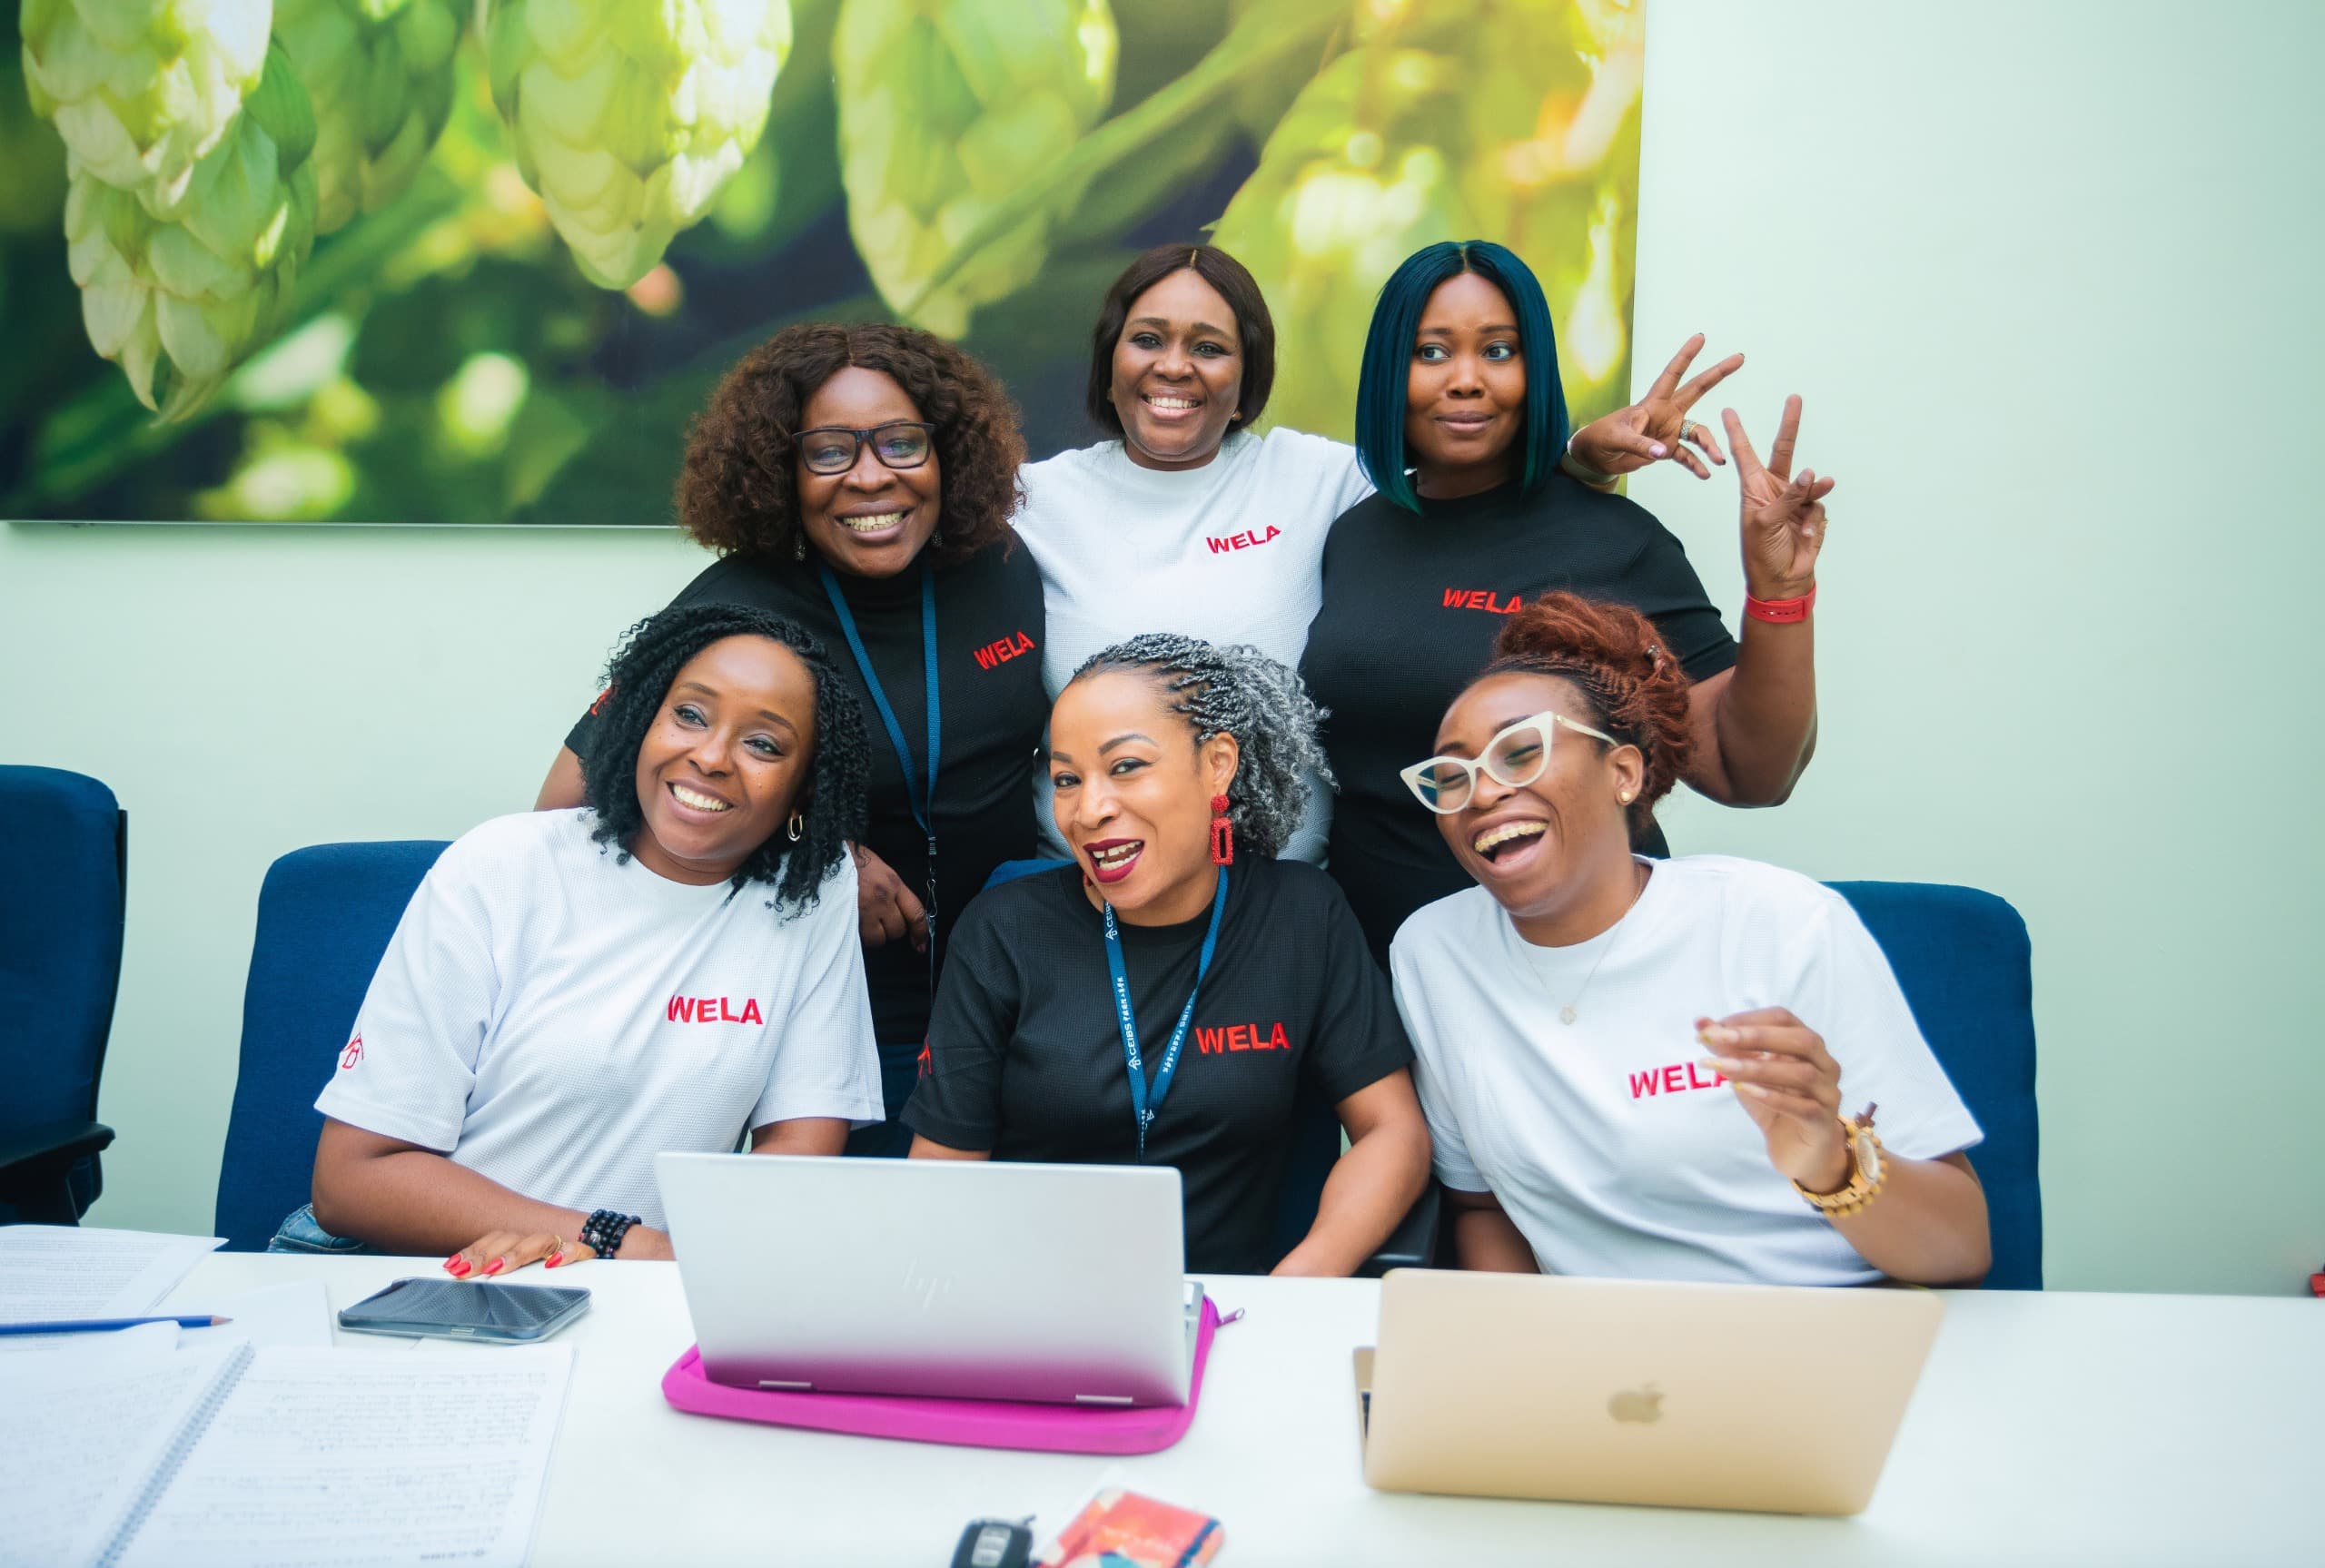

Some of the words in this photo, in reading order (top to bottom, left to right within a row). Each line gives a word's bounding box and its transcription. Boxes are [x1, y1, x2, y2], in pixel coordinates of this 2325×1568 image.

[1206, 525, 1281, 554] WELA
[1441, 587, 1523, 614] WELA
[973, 630, 1035, 670] WELA
[667, 995, 763, 1025] WELA
[1124, 1022, 1136, 1056] CEIBS
[1194, 1021, 1291, 1055] WELA
